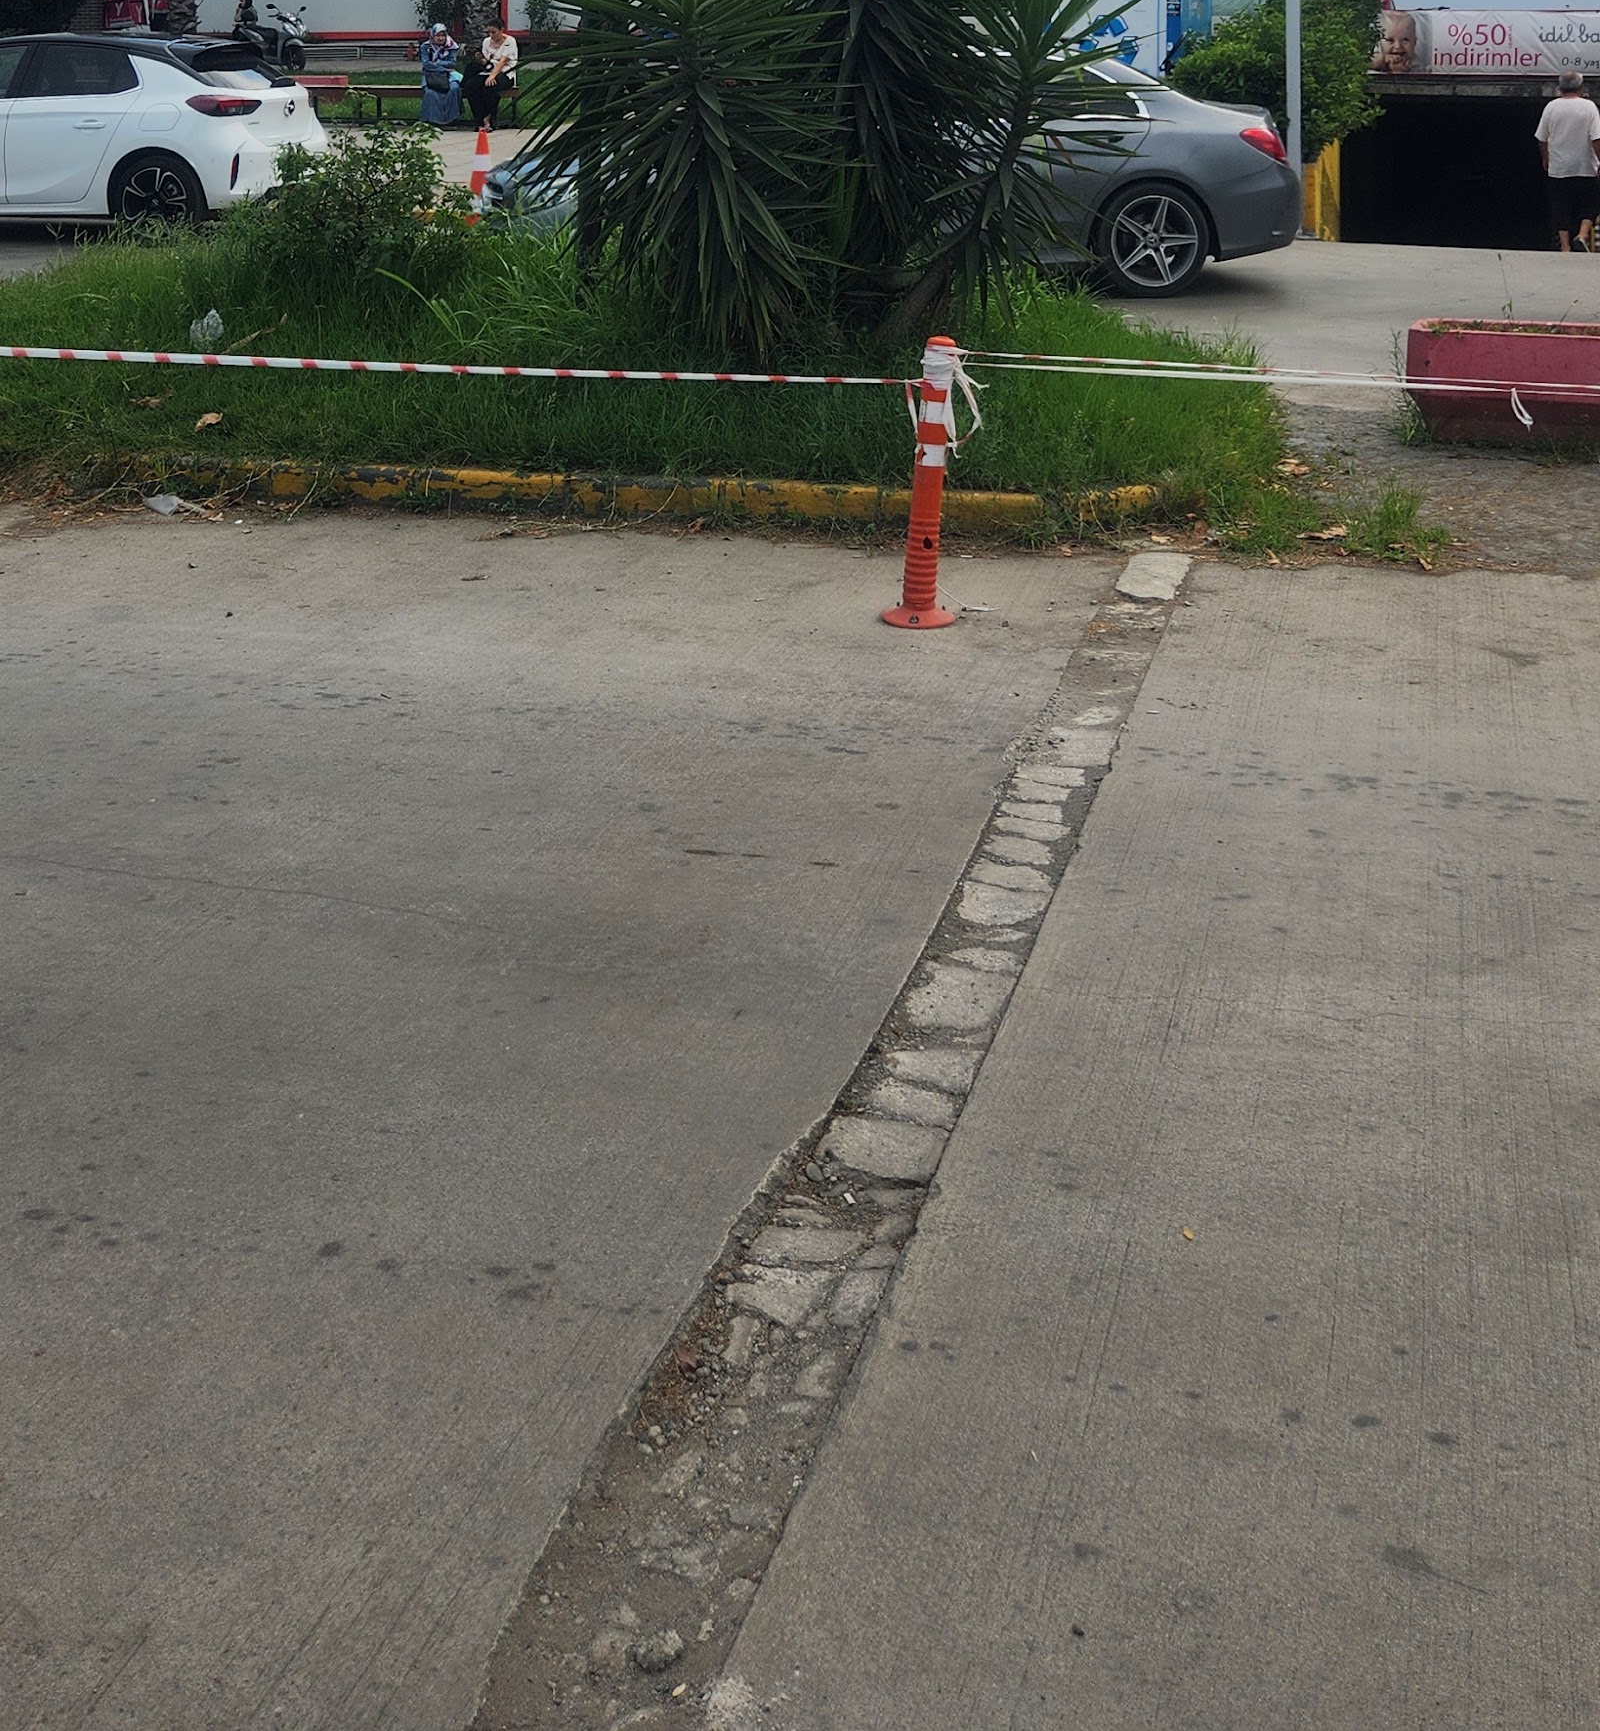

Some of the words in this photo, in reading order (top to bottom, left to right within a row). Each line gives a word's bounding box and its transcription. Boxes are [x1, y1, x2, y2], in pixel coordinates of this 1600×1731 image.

[1448, 23, 1507, 46] %50
[1538, 23, 1576, 43] idil
[1433, 48, 1542, 67] indirimler
[1561, 56, 1581, 67] 0-8
